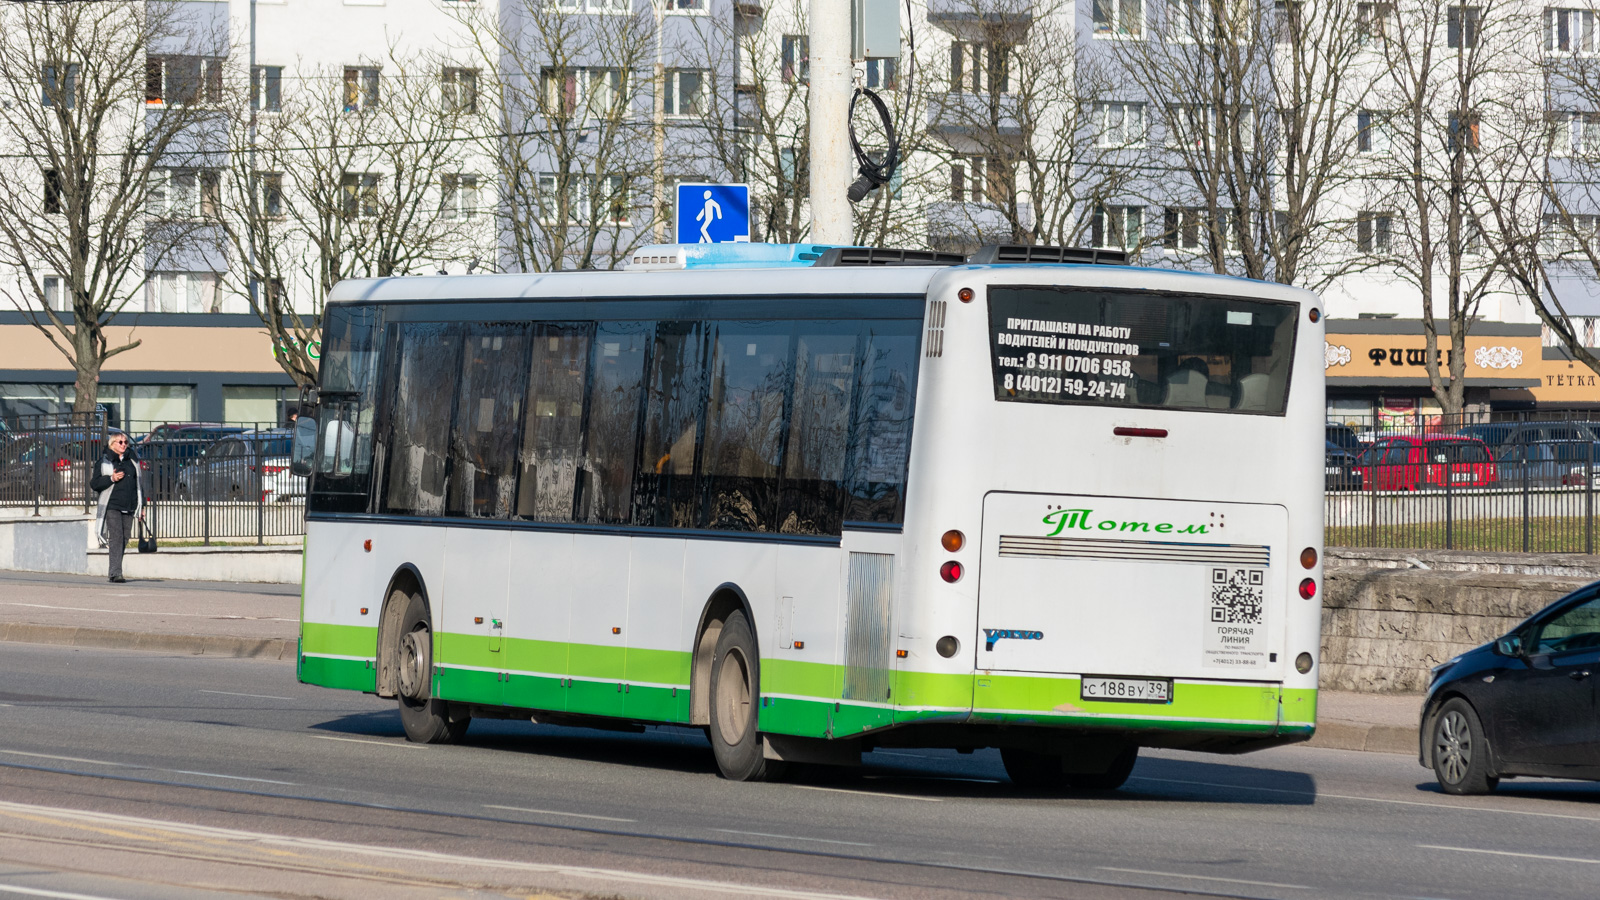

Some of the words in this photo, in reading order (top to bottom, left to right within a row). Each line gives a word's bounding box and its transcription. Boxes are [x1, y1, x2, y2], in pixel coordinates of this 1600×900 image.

[1007, 318, 1077, 335] ПРИГЛАШАЕМ
[1078, 323, 1091, 336] НА
[1092, 325, 1131, 339] РАБОТУ
[998, 333, 1057, 349] ВОДИТЕЛЕЙ
[1058, 338, 1066, 350] И
[1067, 339, 1139, 356] КОНДУКТОРОВ
[998, 356, 1024, 368] тел.:
[1026, 352, 1036, 369] 8
[1039, 353, 1063, 371] 911
[1065, 355, 1100, 374] 0706
[1102, 359, 1133, 379] 958,
[1004, 374, 1014, 389] 8
[1016, 375, 1062, 394] (4012)
[1064, 378, 1126, 399] 59-24-74
[1042, 509, 1209, 537] Тотем
[983, 628, 1044, 640] VOLVO
[1217, 627, 1254, 635] ГОРЯЧАЯ
[1220, 636, 1250, 644] ЛИНИЯ
